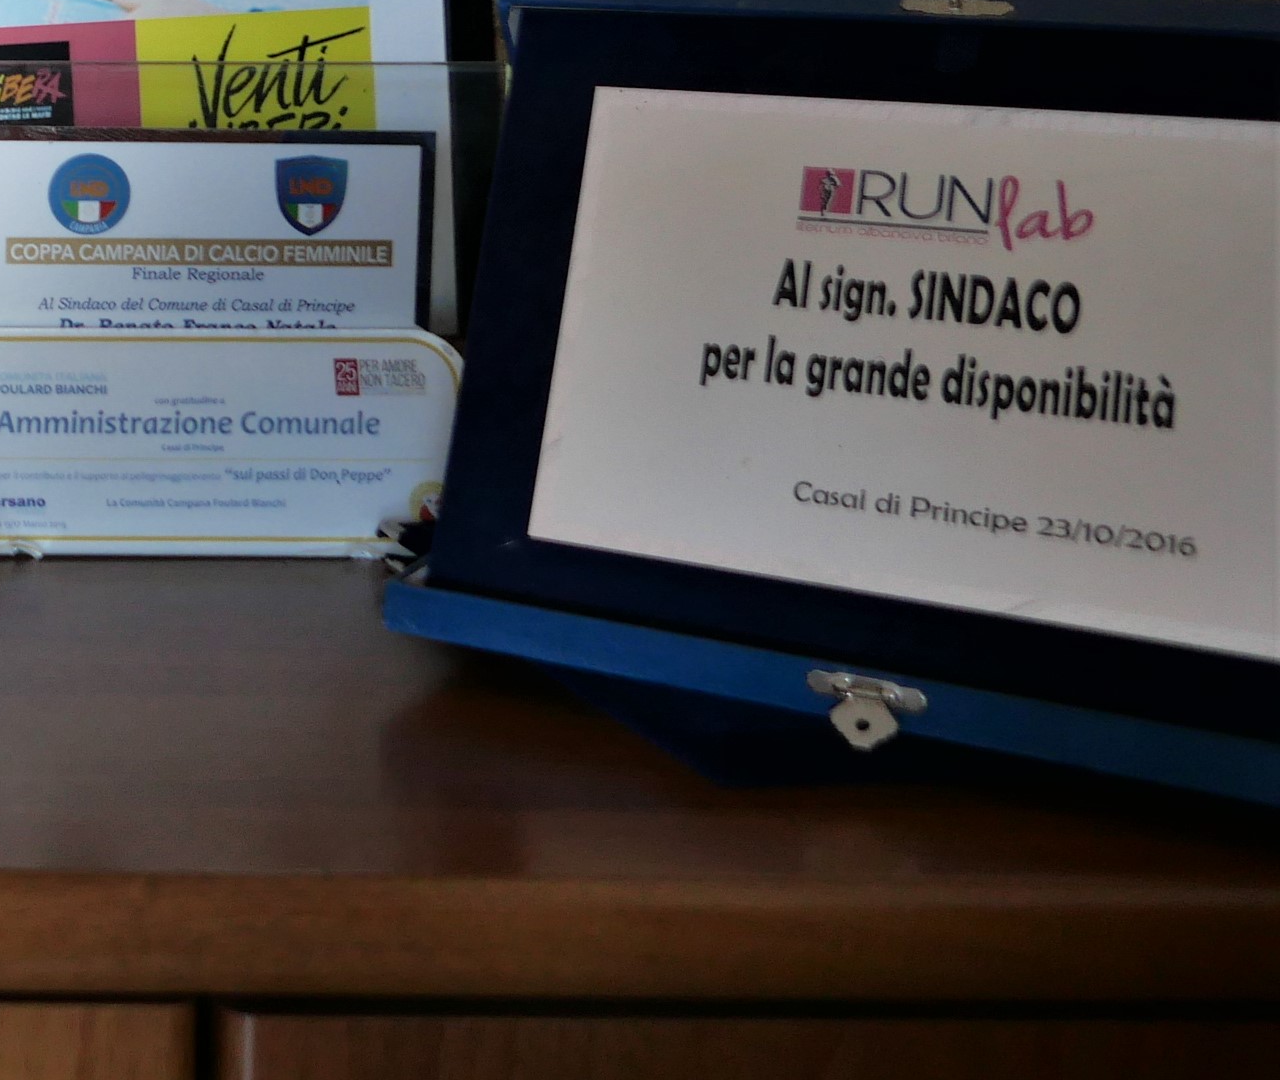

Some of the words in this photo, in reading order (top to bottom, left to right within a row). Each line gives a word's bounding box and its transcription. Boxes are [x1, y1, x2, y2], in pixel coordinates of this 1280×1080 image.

[10, 243, 75, 262] COPPA
[183, 244, 205, 262] DI
[208, 244, 279, 263] CALCIO
[283, 245, 388, 265] FEMMINILE
[131, 266, 184, 282] Finale
[187, 266, 265, 284] Regionale
[38, 297, 55, 312] Al
[58, 297, 117, 313] Sindaco
[120, 297, 144, 312] del
[147, 298, 208, 313] Comune
[211, 298, 228, 313] di
[231, 298, 275, 313] Casal
[277, 298, 294, 313] di
[296, 298, 356, 317] Principe
[772, 258, 812, 307] Al
[818, 263, 897, 321] sign.
[908, 268, 1081, 334] SINDACO
[55, 383, 108, 395] BIANCHI
[700, 338, 755, 386] per
[764, 334, 795, 386] la
[805, 348, 931, 401] grande
[940, 353, 1176, 430] disponibilità
[240, 409, 381, 436] Comunale
[256, 468, 290, 484] passi
[292, 467, 306, 481] di
[309, 468, 336, 482] Don
[793, 480, 868, 512] Casal
[873, 491, 903, 516] di
[909, 495, 1028, 535] Principe
[1035, 514, 1198, 557] 23/10/2016
